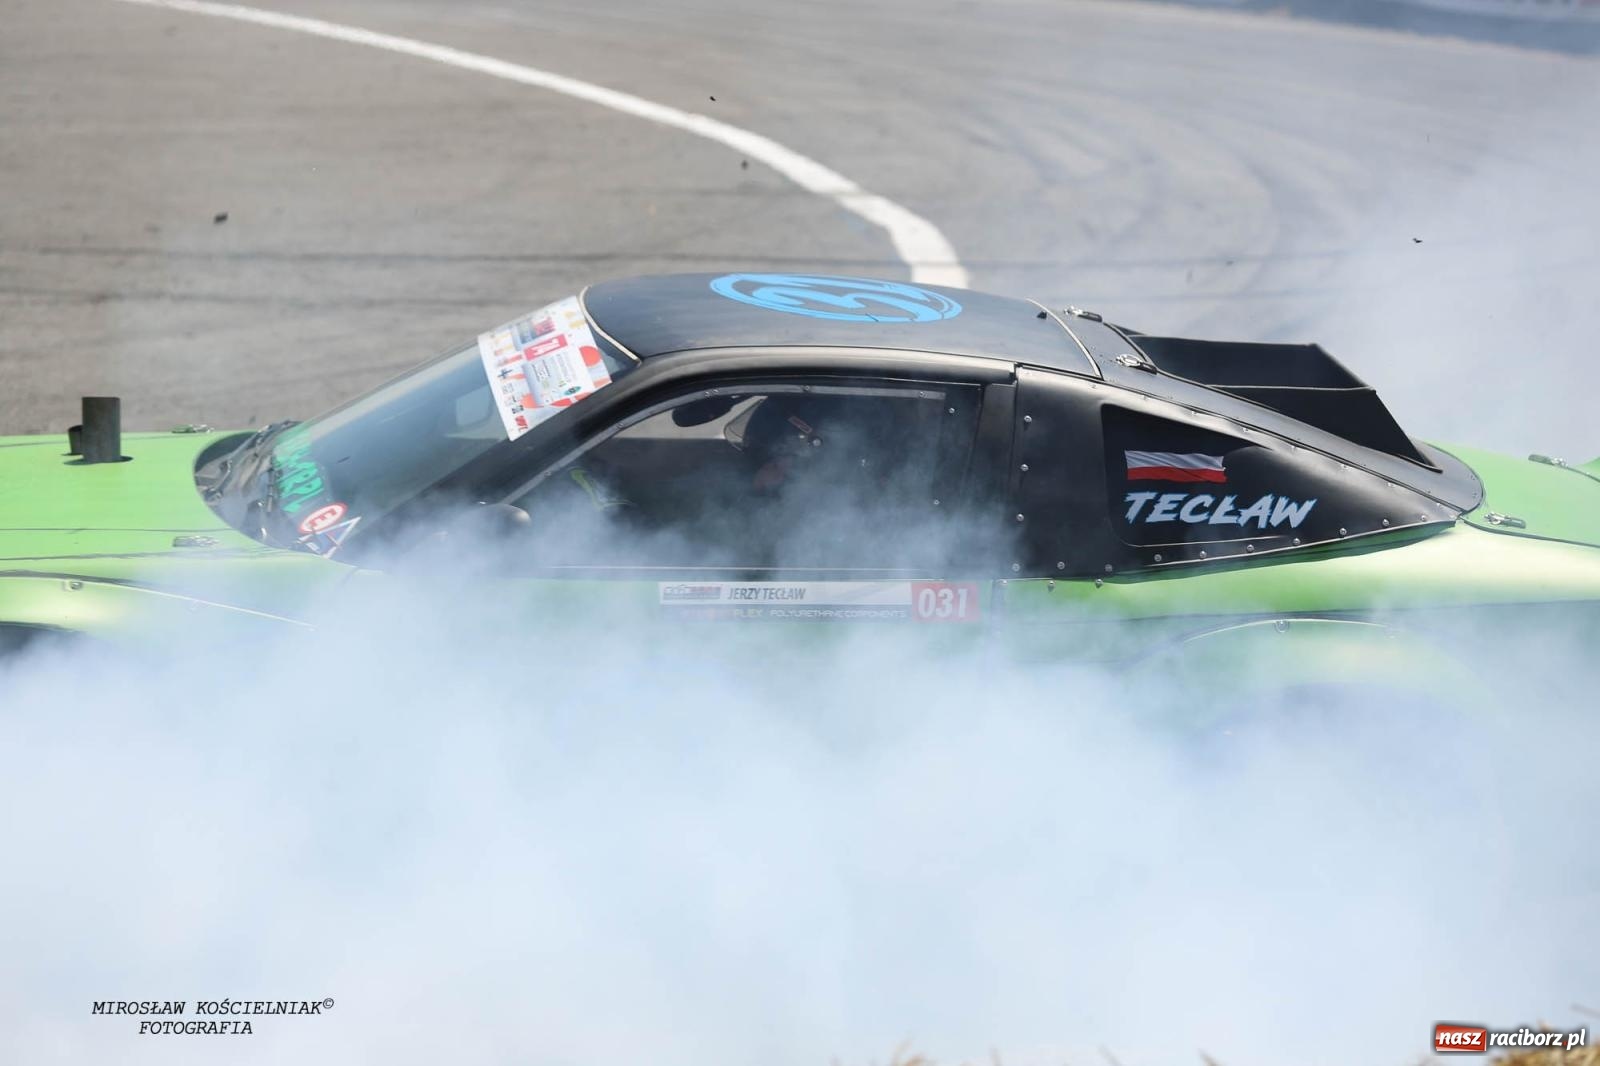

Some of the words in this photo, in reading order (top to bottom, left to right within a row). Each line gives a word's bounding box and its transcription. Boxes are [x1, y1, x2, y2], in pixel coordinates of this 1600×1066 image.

[1124, 491, 1317, 529] TECŁAW
[728, 587, 761, 600] JERZY
[763, 587, 806, 600] TECŁAW
[917, 588, 969, 618] 031
